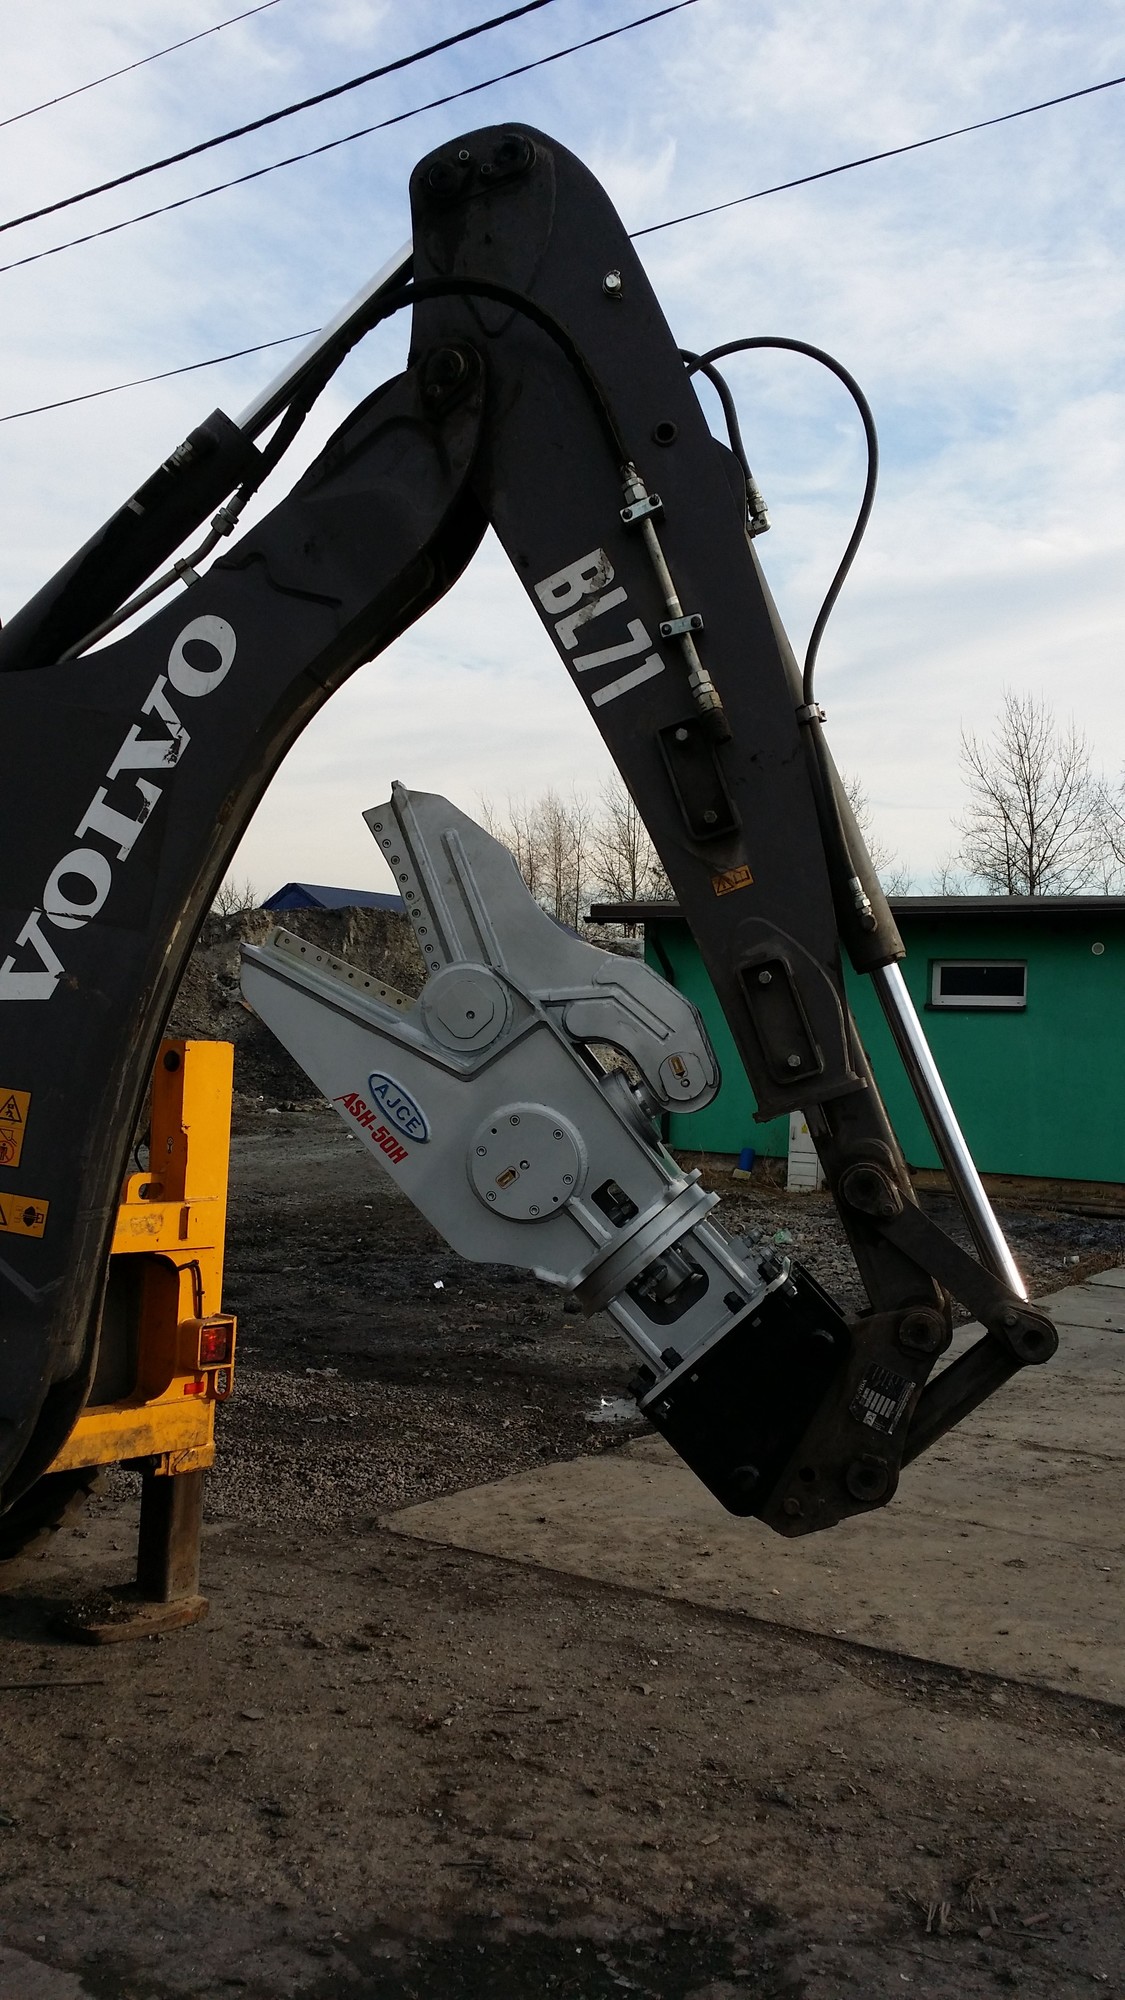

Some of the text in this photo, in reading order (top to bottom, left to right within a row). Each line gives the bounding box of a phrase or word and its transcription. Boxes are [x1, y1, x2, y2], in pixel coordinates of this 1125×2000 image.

[534, 548, 666, 708] BL71
[0, 614, 237, 1001] VOLVO
[333, 1092, 409, 1165] ASH-50H
[374, 1083, 421, 1134] AJCE
